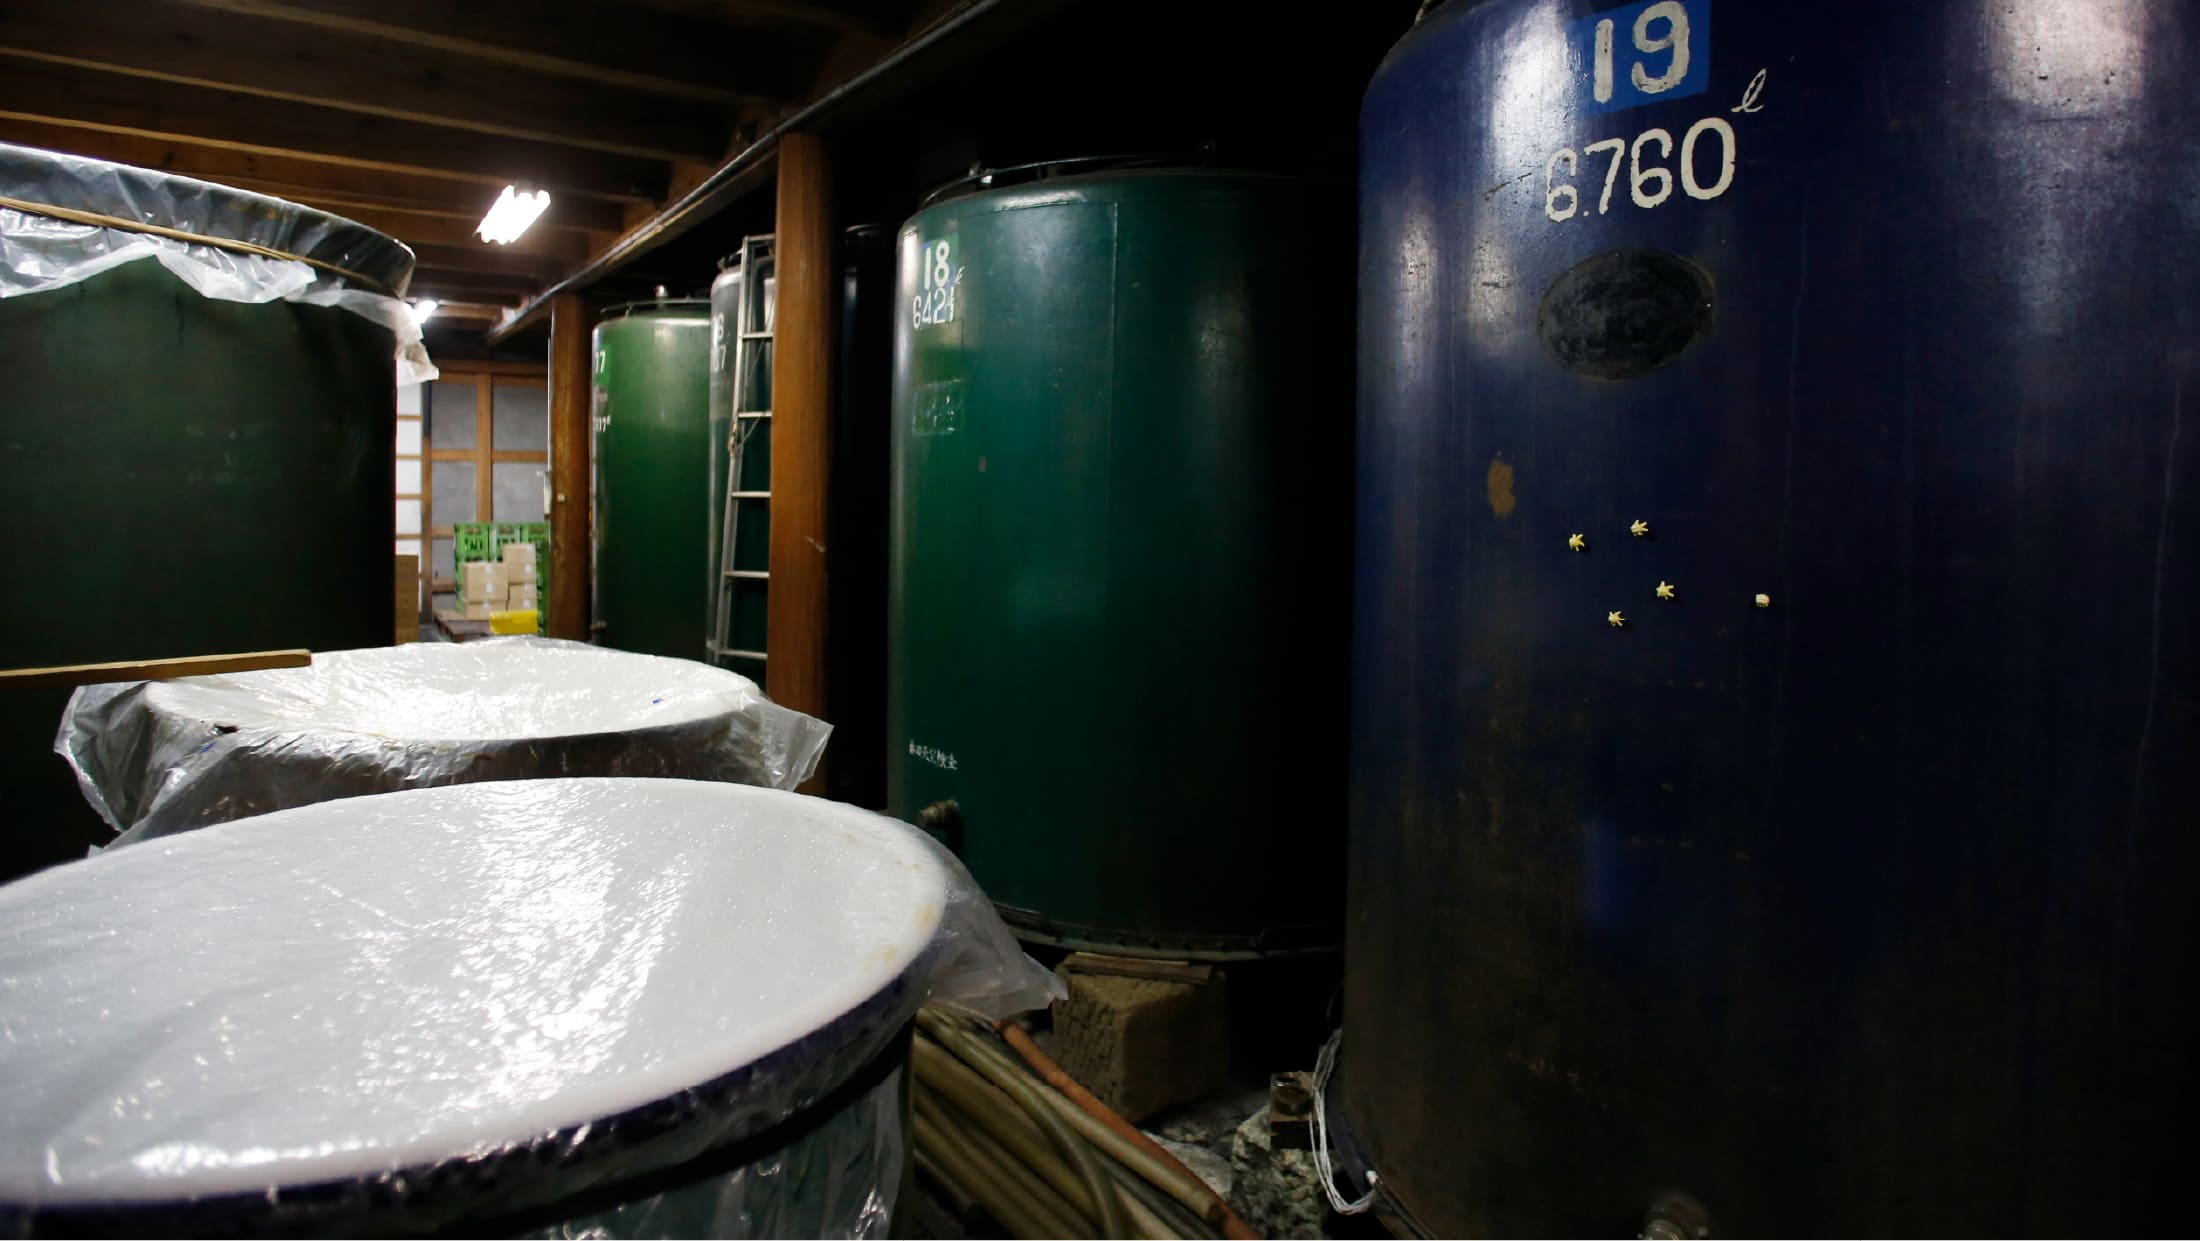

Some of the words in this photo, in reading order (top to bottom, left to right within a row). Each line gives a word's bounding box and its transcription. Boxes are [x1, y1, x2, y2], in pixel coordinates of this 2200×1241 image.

[1593, 0, 1691, 104] 19
[1544, 116, 1737, 223] 6.760
[924, 239, 951, 290] 18
[912, 286, 955, 330] 6421
